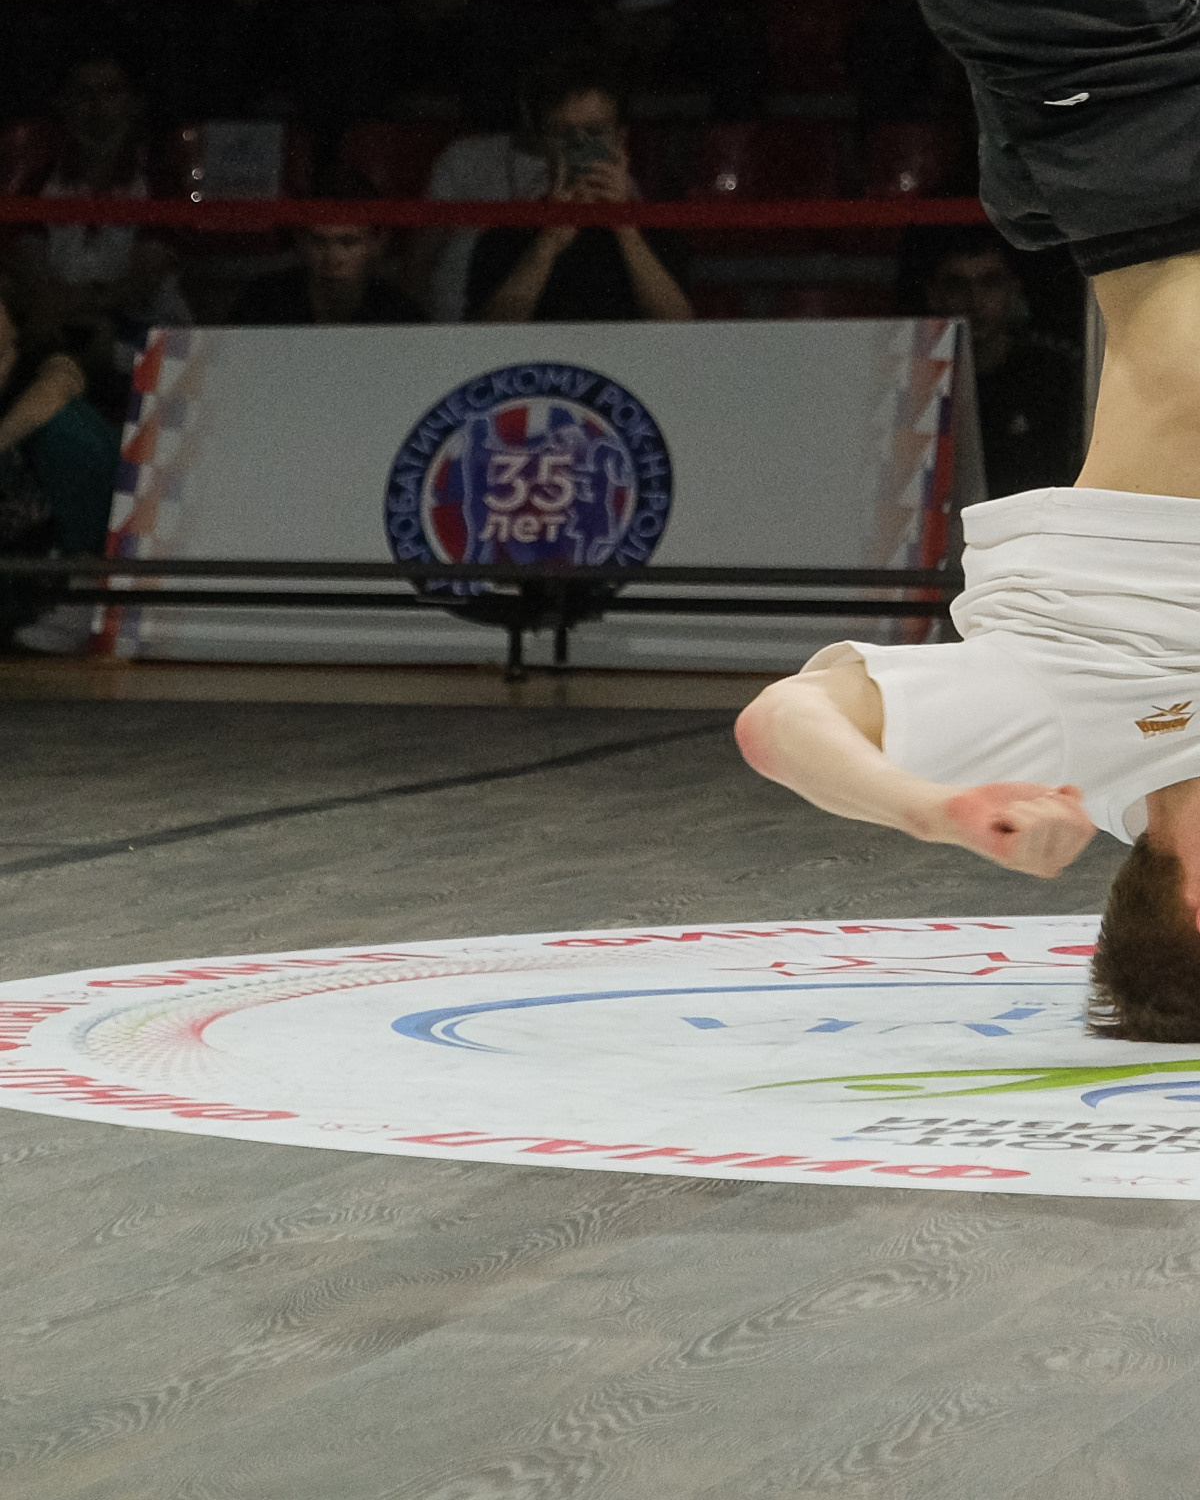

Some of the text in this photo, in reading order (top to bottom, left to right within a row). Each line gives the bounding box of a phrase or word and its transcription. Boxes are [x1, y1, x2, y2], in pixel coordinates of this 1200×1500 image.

[388, 368, 597, 563] РОБАТИЧЕСКОМУ
[484, 454, 577, 512] 35
[541, 922, 1015, 947] ФИНАЛ
[86, 952, 446, 989] ФИНАЛ
[394, 1131, 1032, 1179] ФИНАЛ
